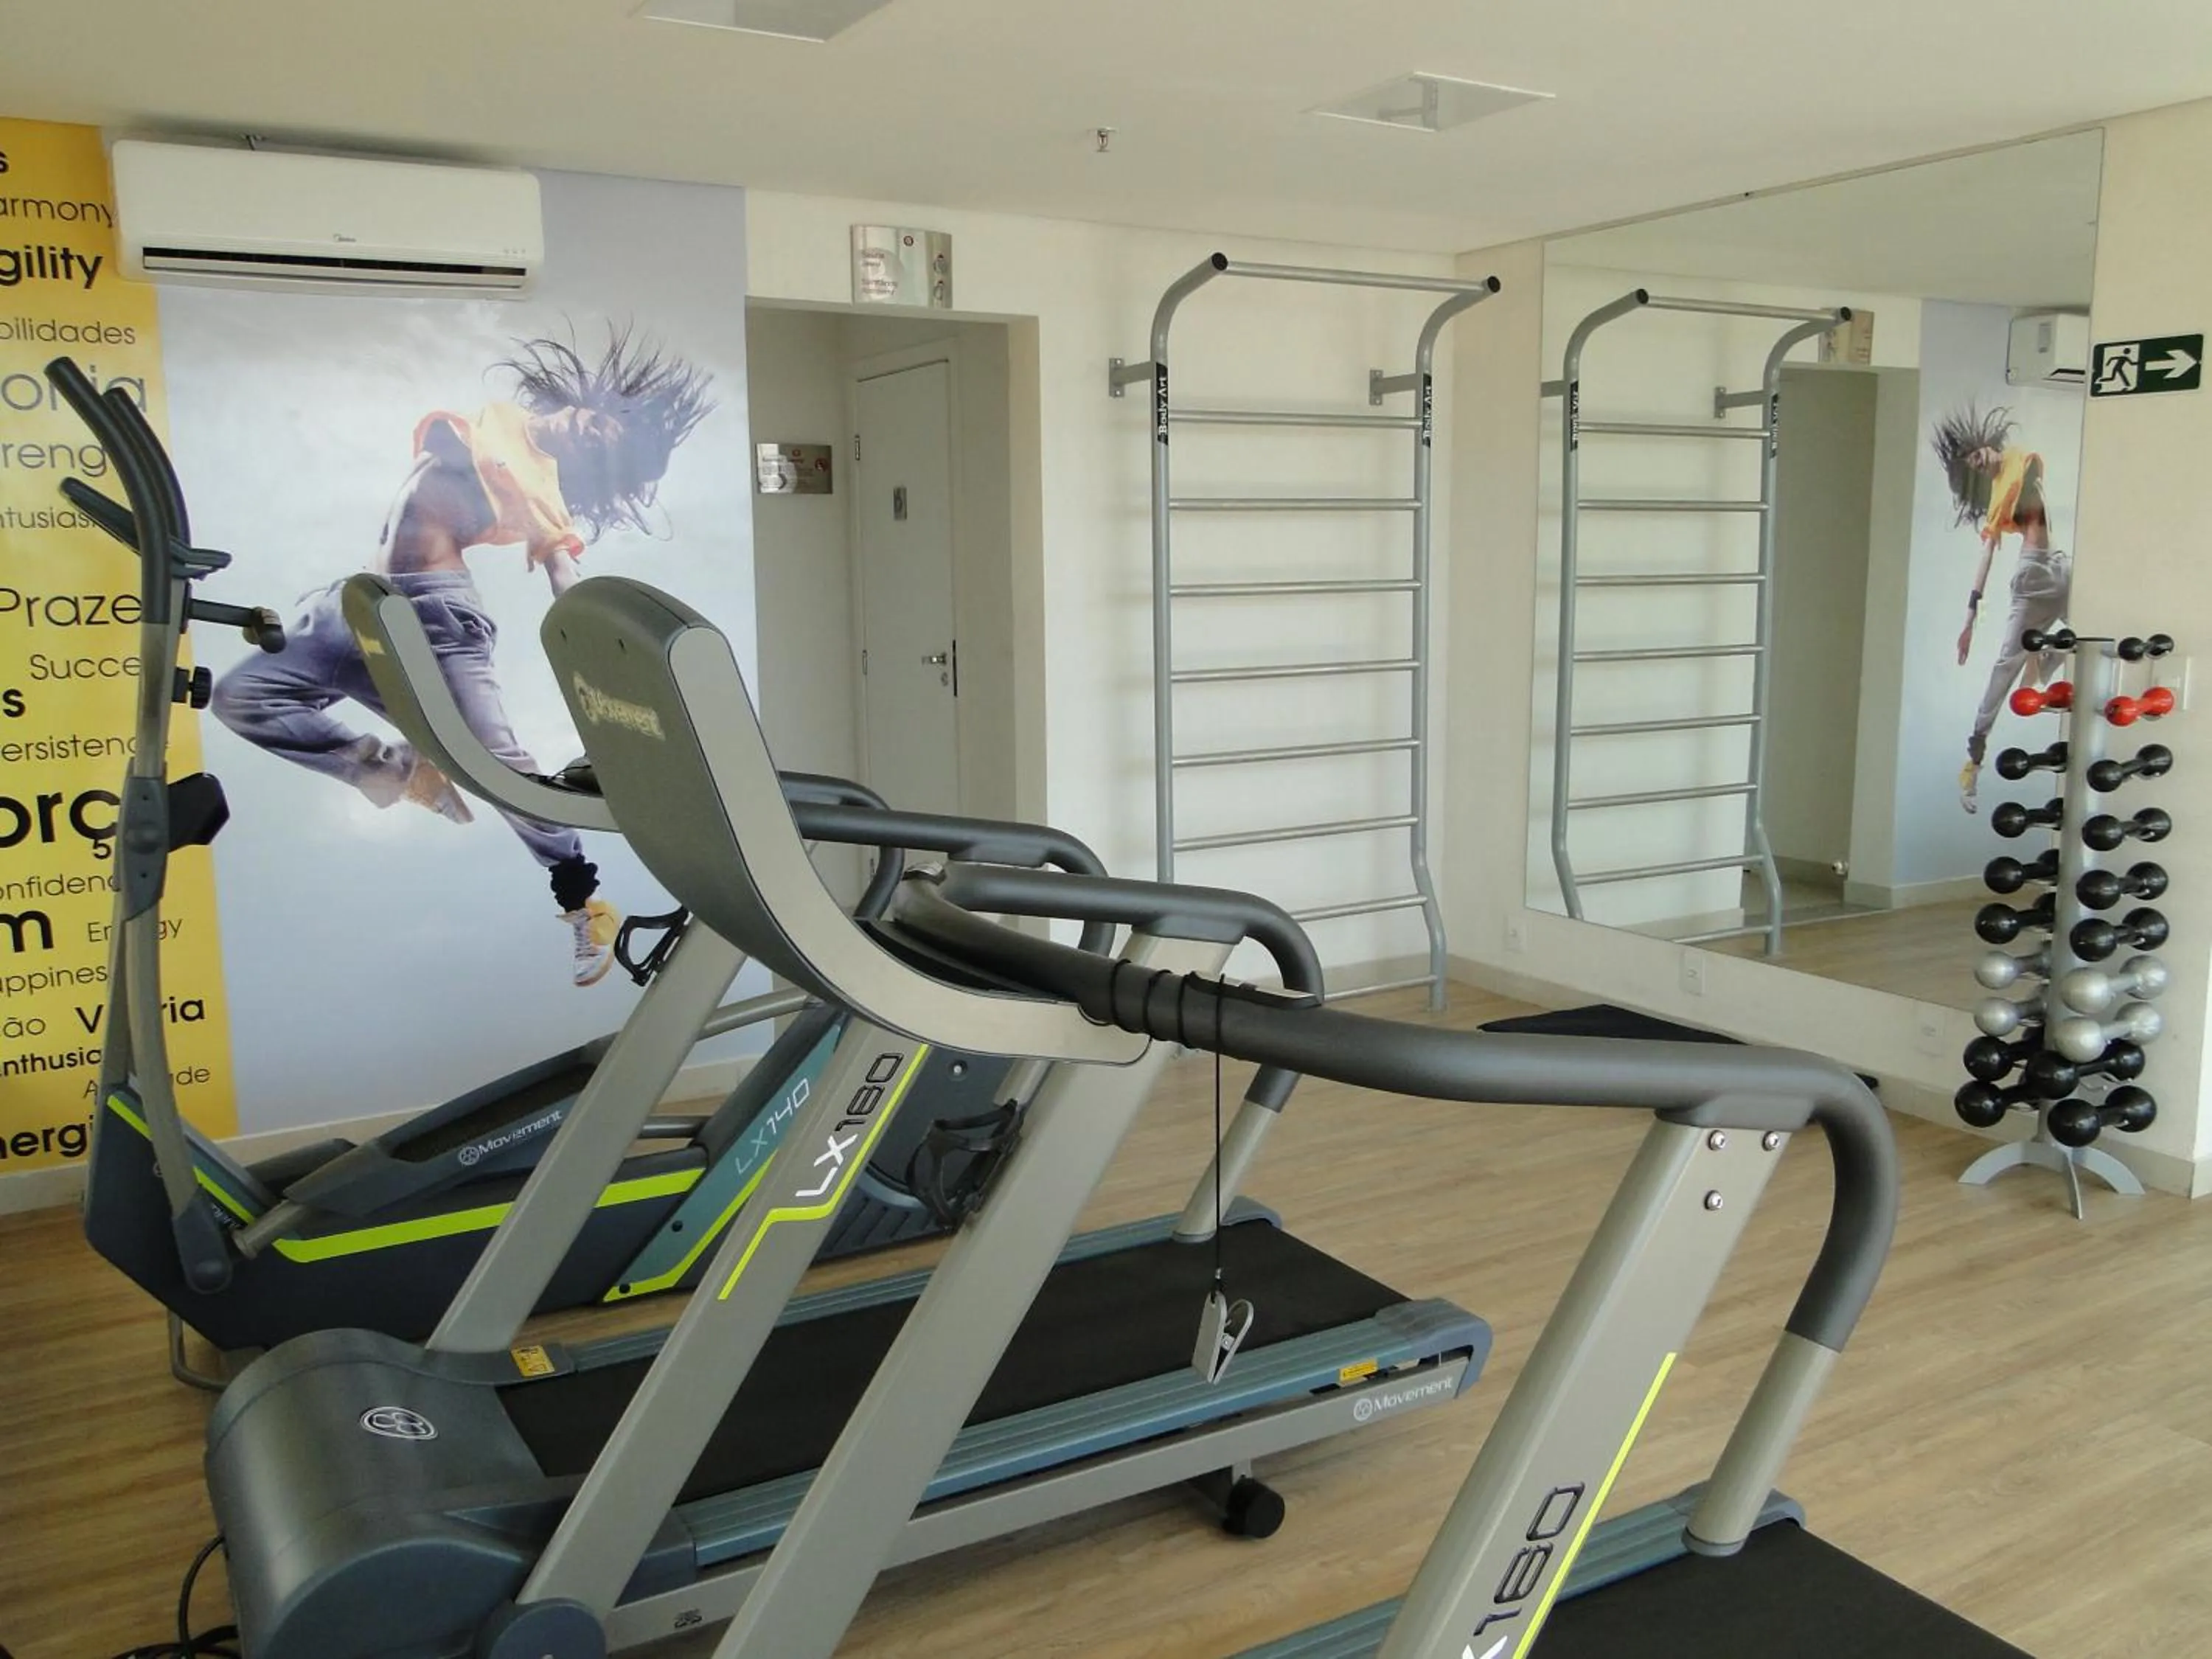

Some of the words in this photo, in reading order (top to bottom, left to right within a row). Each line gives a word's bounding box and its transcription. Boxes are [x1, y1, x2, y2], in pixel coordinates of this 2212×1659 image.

[0, 507, 94, 529] tusias
[0, 873, 120, 900] nfidenc
[0, 964, 108, 996] ppines
[0, 1046, 102, 1077] nthusia
[479, 1109, 563, 1155] Movement
[1374, 1375, 1453, 1412] Movement
